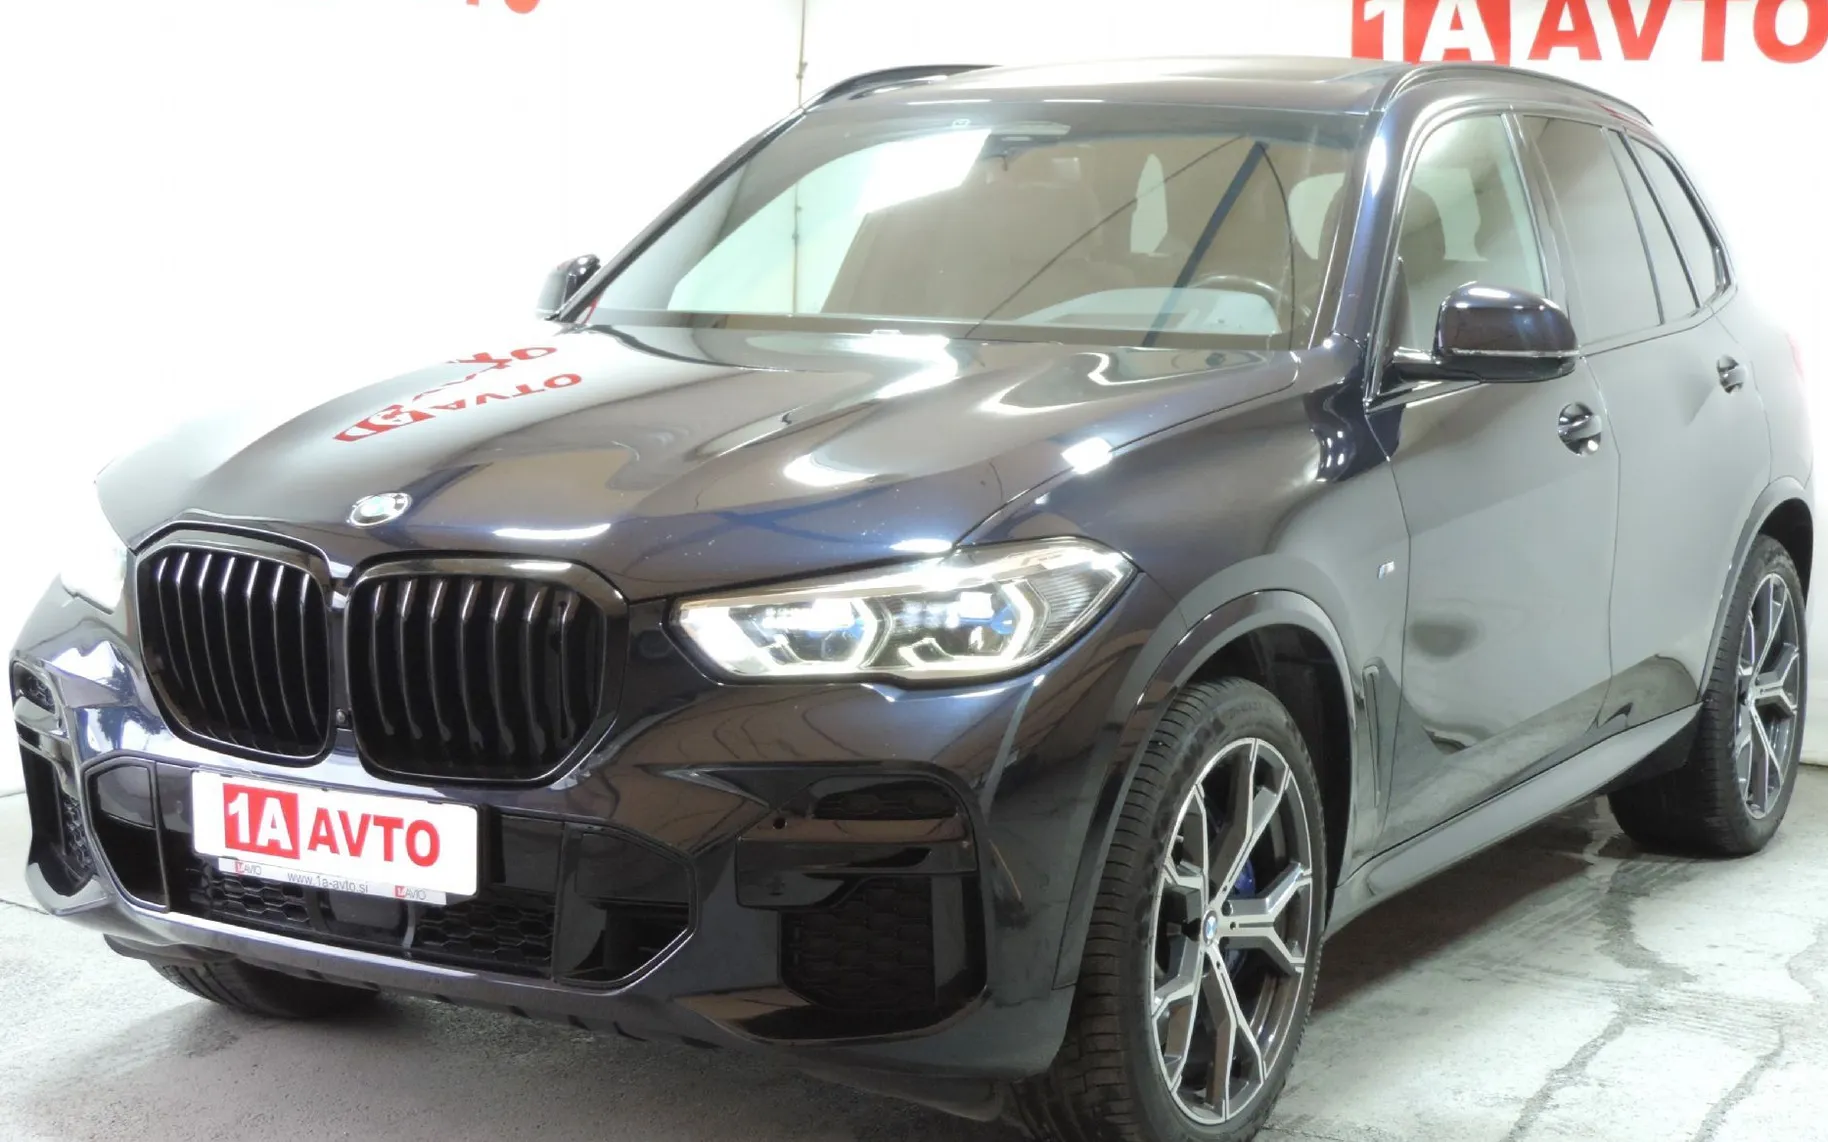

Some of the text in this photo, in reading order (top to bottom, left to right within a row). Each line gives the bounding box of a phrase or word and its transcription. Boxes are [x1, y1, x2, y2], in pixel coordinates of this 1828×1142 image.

[1361, 0, 1828, 63] 1A AVTO
[227, 791, 441, 868] 1A AVTO
[286, 871, 369, 894] www.1a-avto.si
